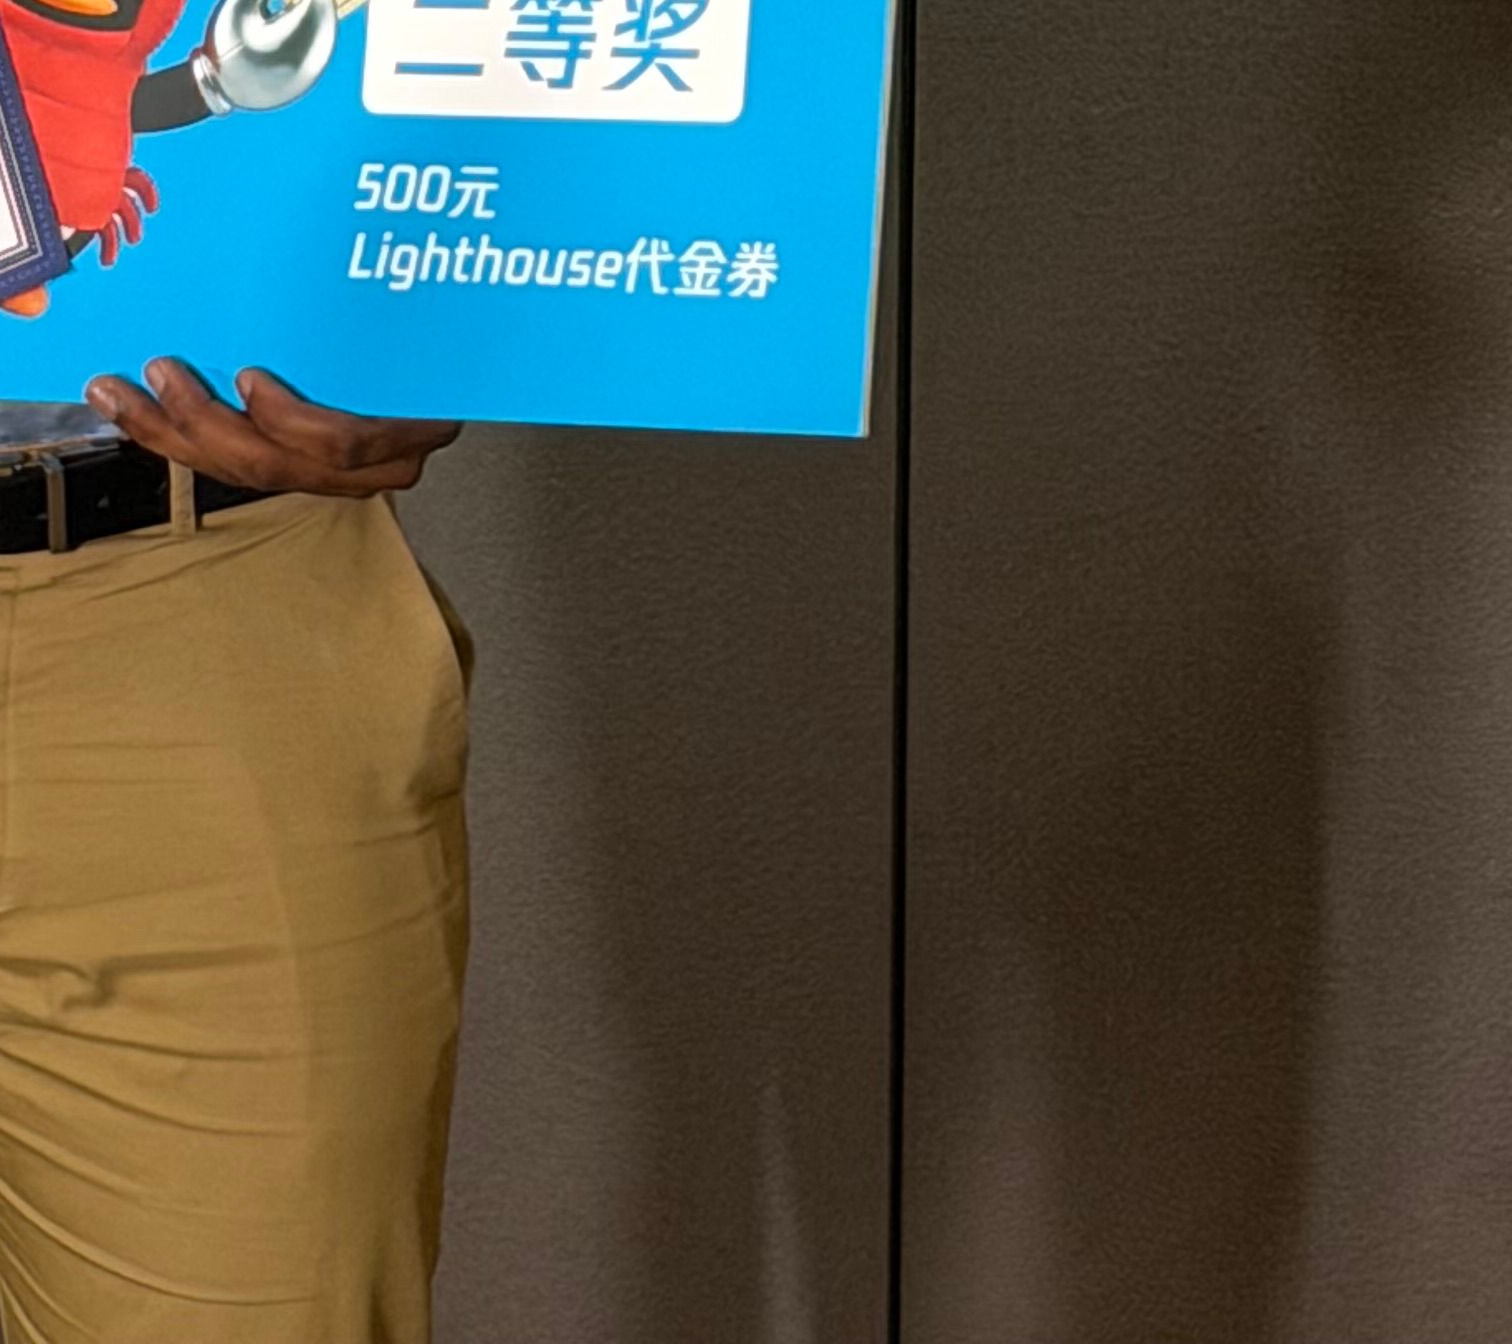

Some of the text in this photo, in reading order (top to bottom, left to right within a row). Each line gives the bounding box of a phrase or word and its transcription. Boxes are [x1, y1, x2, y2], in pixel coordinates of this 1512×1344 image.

[353, 163, 500, 220] 500元
[347, 231, 781, 299] Lighthouse代金券
